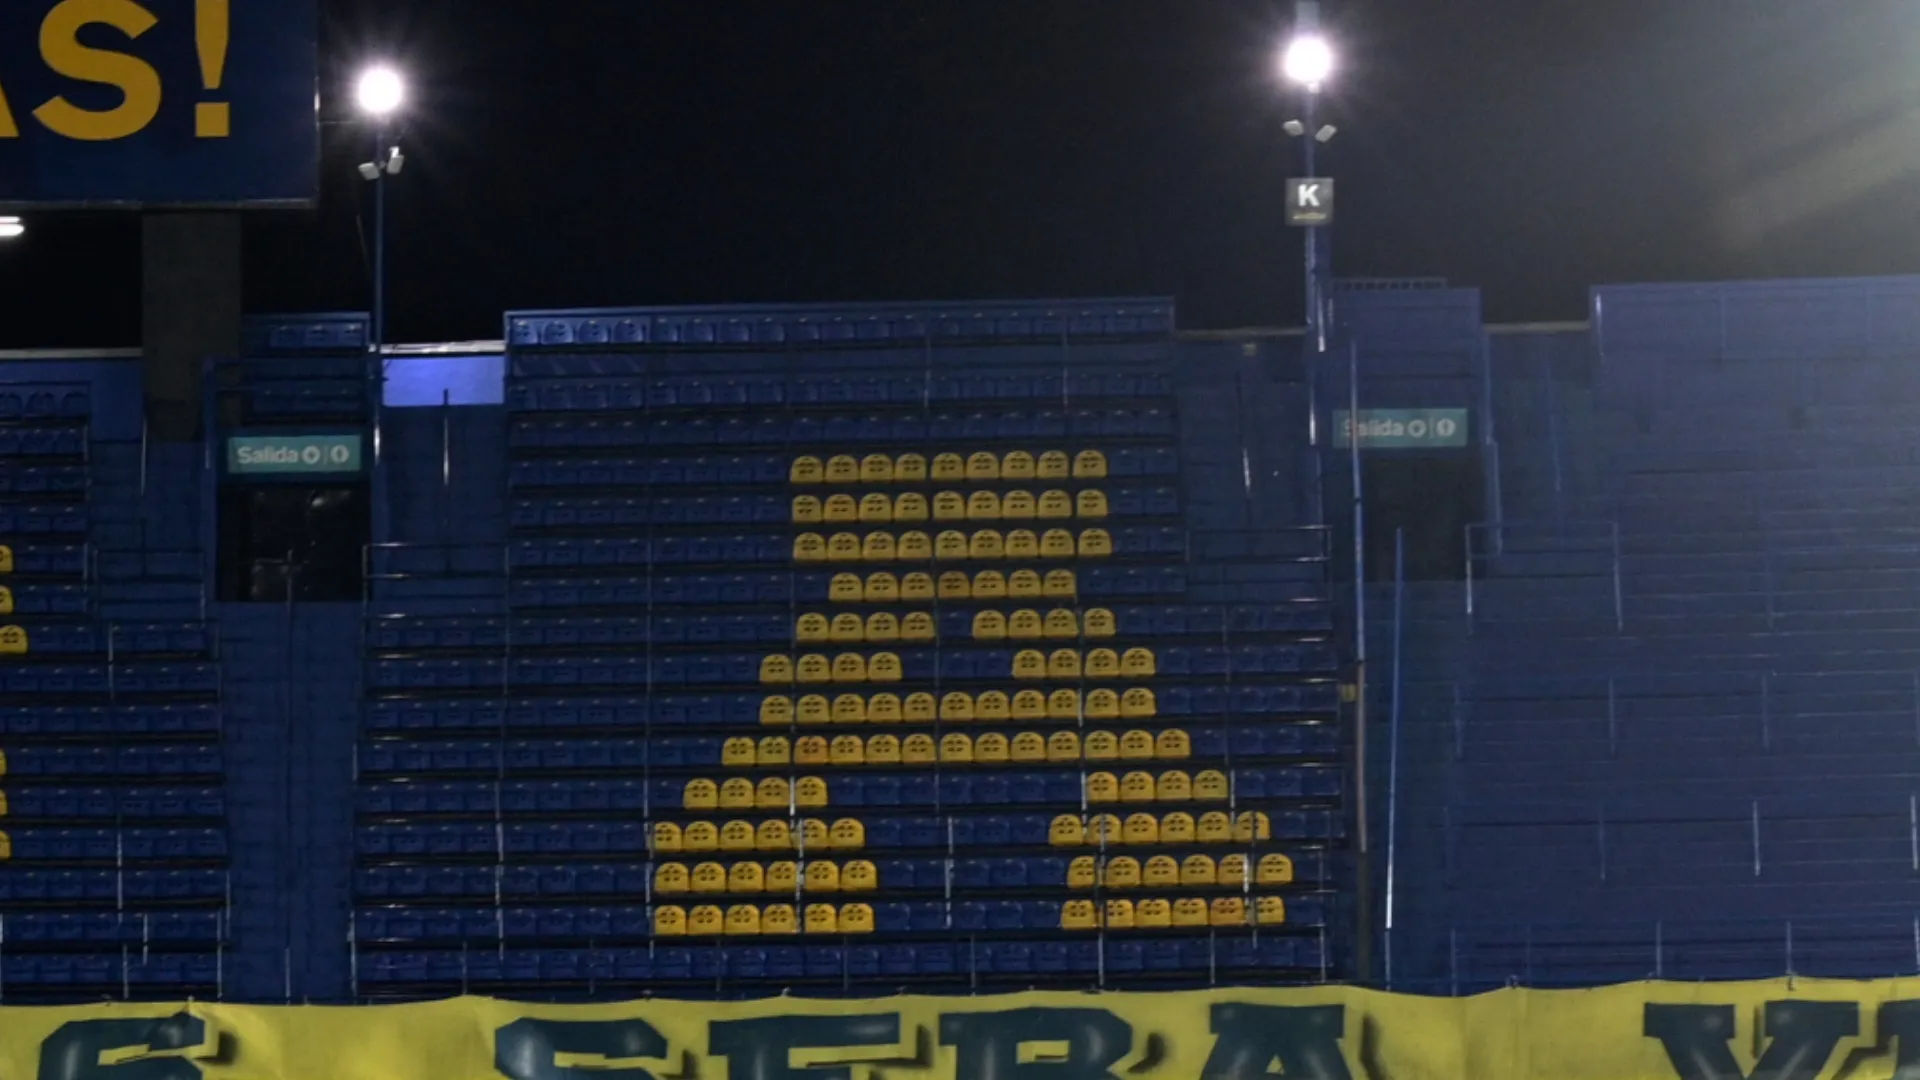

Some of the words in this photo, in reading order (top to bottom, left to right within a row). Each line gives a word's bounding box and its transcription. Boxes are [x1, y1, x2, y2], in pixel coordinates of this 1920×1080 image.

[0, 0, 230, 140] S!
[1298, 184, 1320, 206] K
[237, 444, 299, 464] Salida
